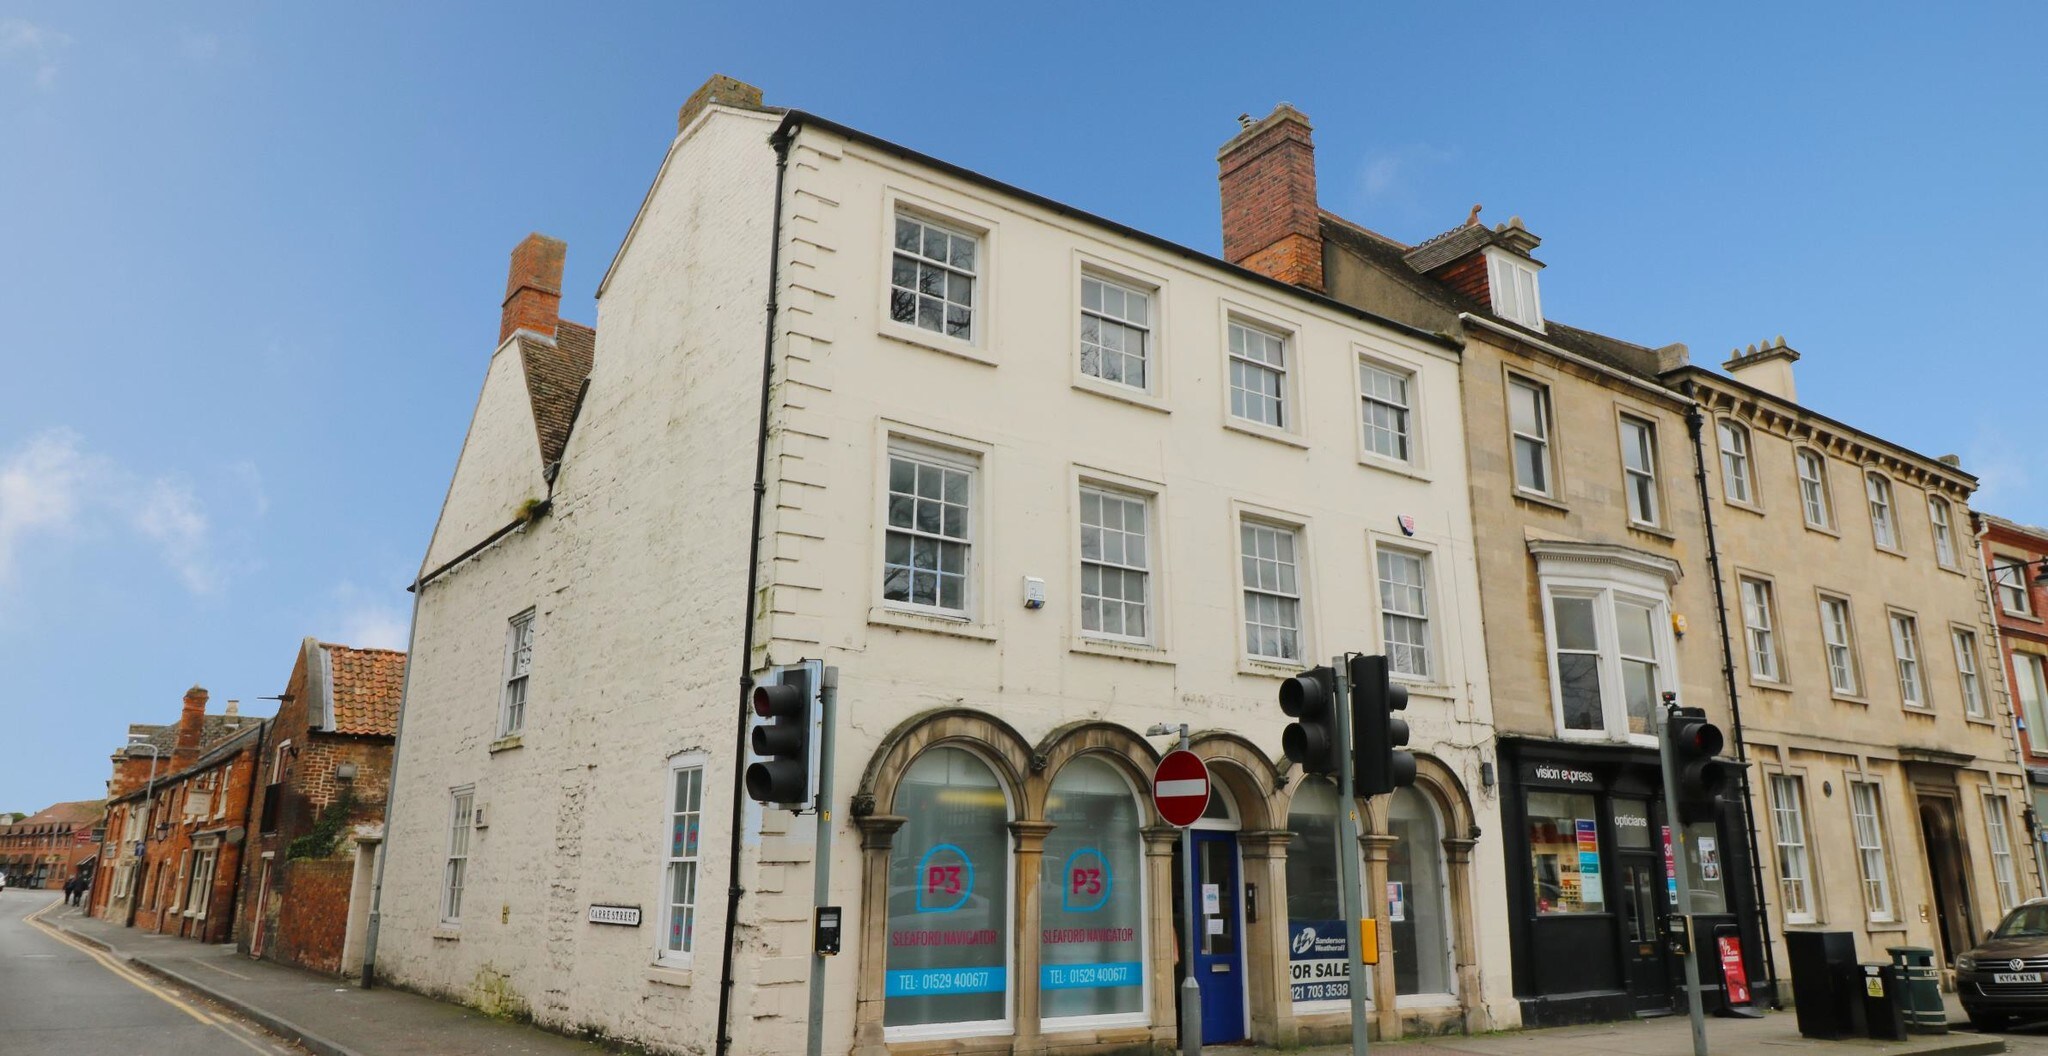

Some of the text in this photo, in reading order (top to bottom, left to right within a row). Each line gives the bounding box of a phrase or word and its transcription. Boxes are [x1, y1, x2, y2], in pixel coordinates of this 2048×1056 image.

[1536, 765, 1593, 784] vision express
[1614, 814, 1648, 828] opticians
[928, 866, 961, 894] P3
[1073, 868, 1101, 895] P3
[612, 910, 636, 922] STREET
[892, 928, 997, 947] SLEAFORD NAVIGATOR
[1042, 927, 1133, 944] SLEAFORD NAVIGATOR
[1315, 936, 1346, 945] Sanderson
[1315, 944, 1346, 952] Weatherall
[1049, 967, 1127, 984] TEL: 01529 400677
[1315, 962, 1350, 978] SALE
[899, 971, 989, 990] TEL: 01529 400677
[1307, 985, 1324, 998] 703
[1325, 983, 1349, 997] 3538
